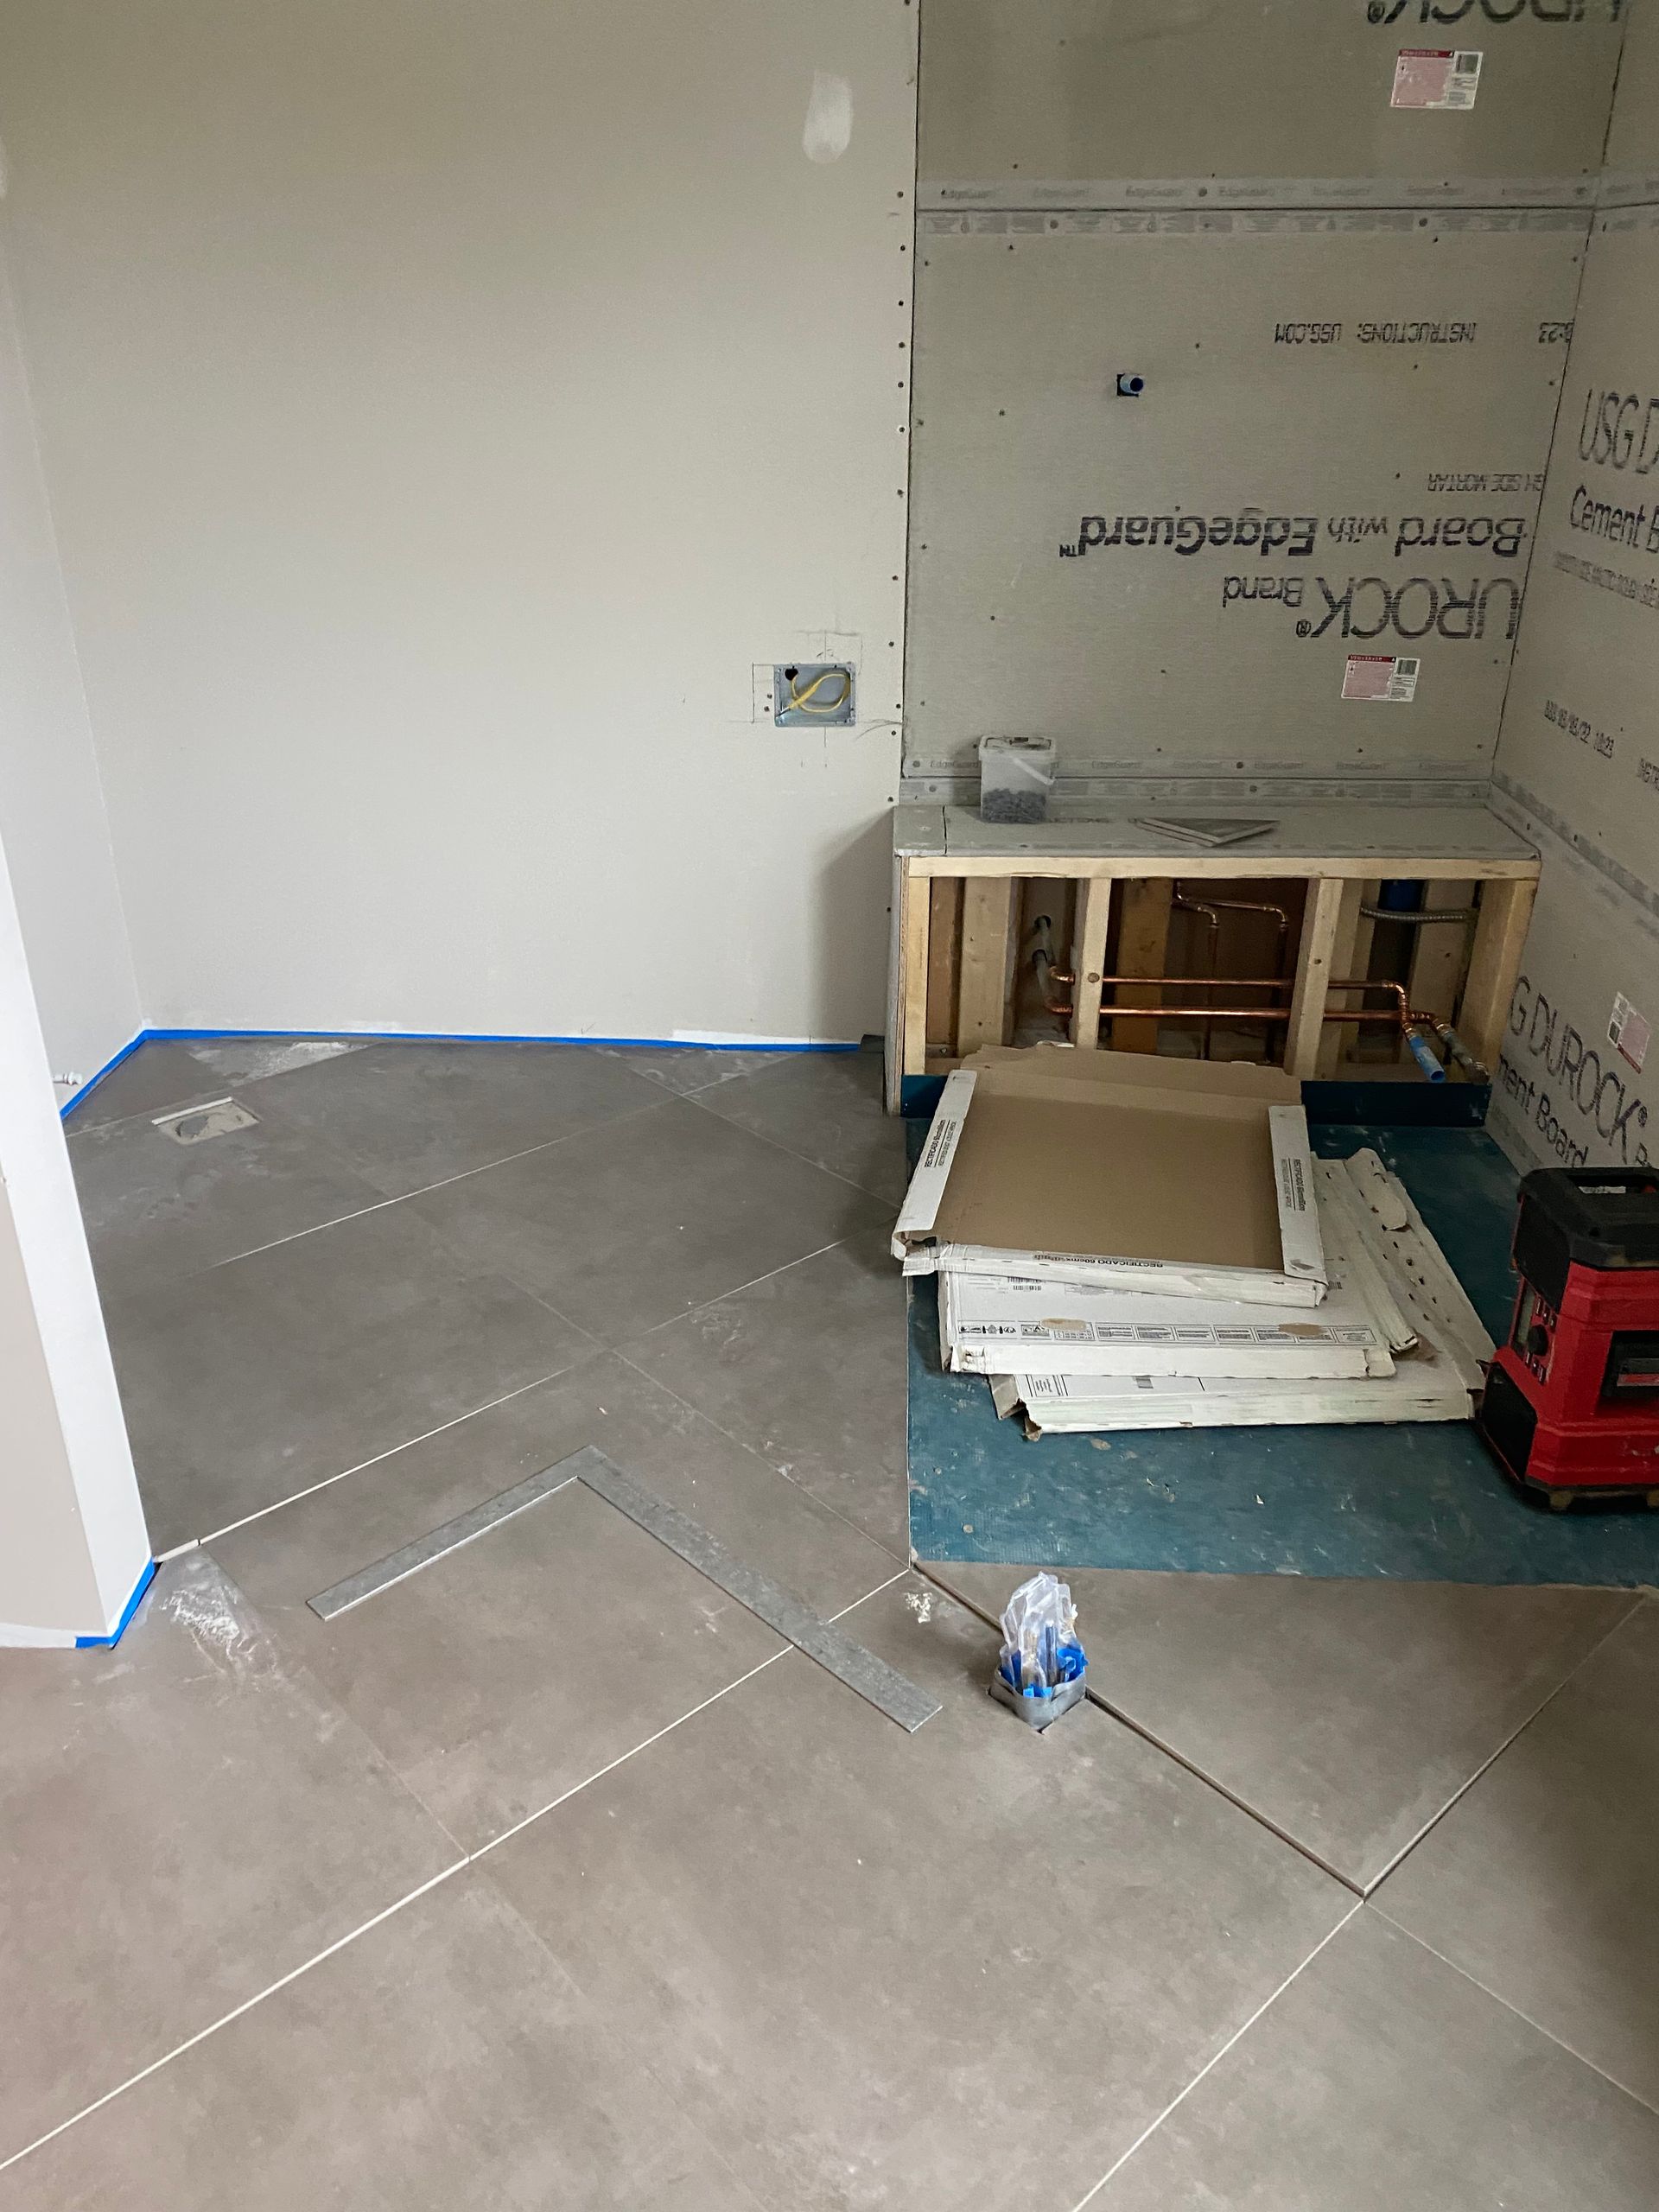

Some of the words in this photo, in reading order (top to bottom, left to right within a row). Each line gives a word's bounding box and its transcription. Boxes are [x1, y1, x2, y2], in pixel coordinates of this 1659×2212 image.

[1275, 322, 1341, 344] USG.COM
[1357, 322, 1476, 344] INSTRUCTIONS:
[1579, 389, 1639, 469] USG
[1427, 474, 1486, 492] MORTAR
[1327, 516, 1389, 543] with
[1570, 485, 1645, 549] Cement
[1394, 518, 1526, 557] Board
[1223, 576, 1304, 607] Brand
[1098, 1259, 1164, 1268] RECTIFICADO
